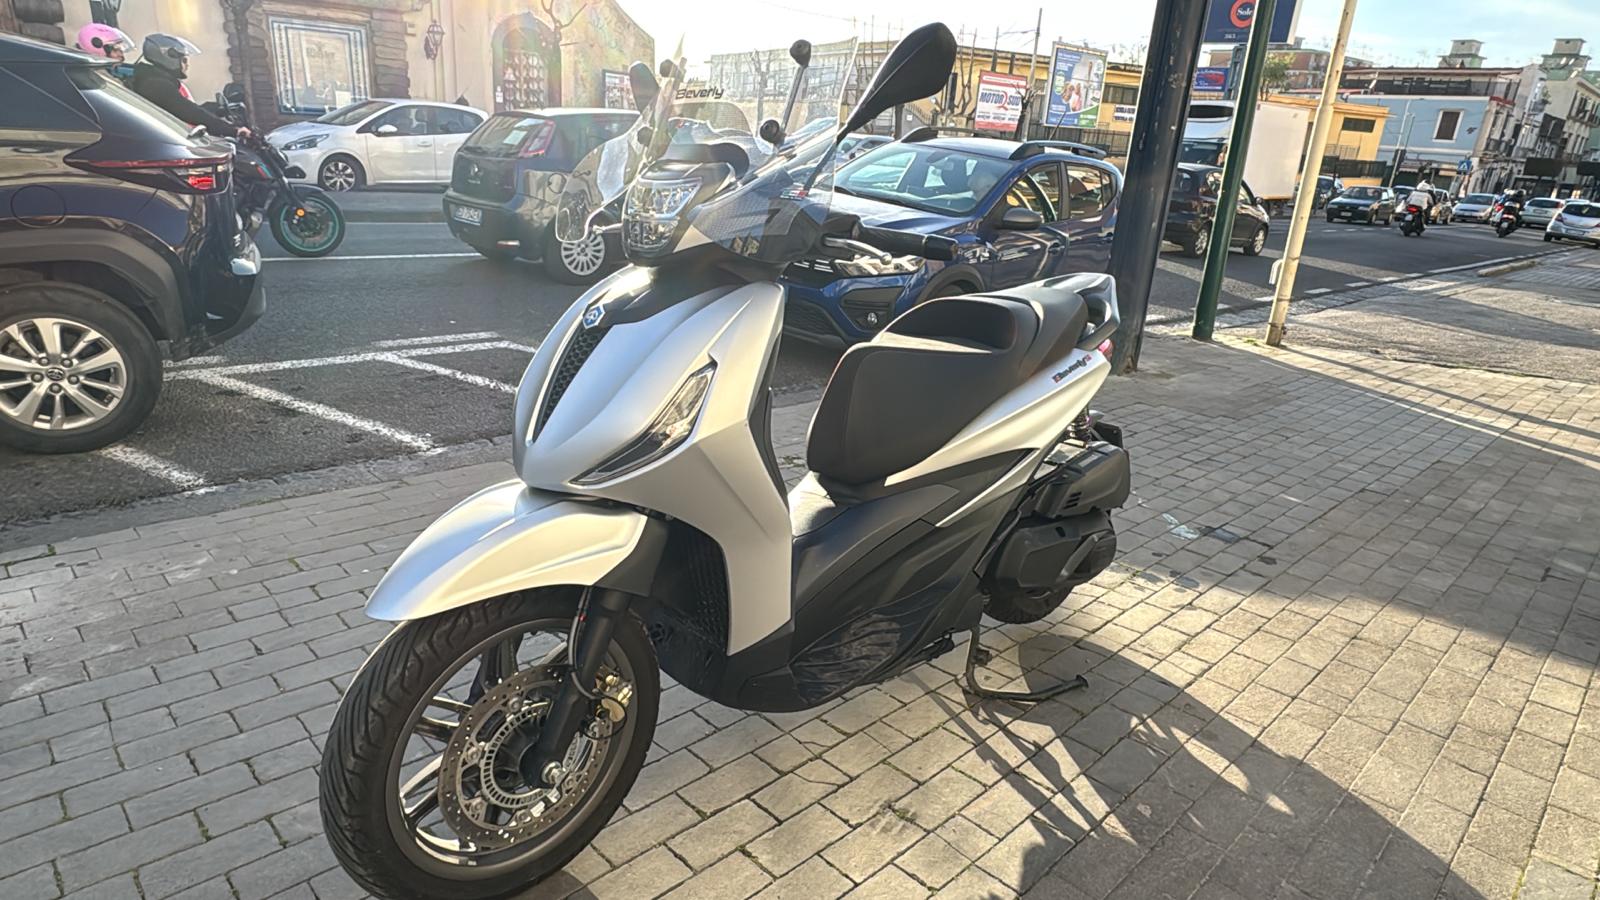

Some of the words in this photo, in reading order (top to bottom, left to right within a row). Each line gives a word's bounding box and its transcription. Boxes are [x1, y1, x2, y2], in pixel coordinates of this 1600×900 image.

[1237, 7, 1253, 16] Sole
[675, 86, 724, 100] Beverly
[979, 91, 1005, 104] MOTOR
[1007, 94, 1021, 106] SUD
